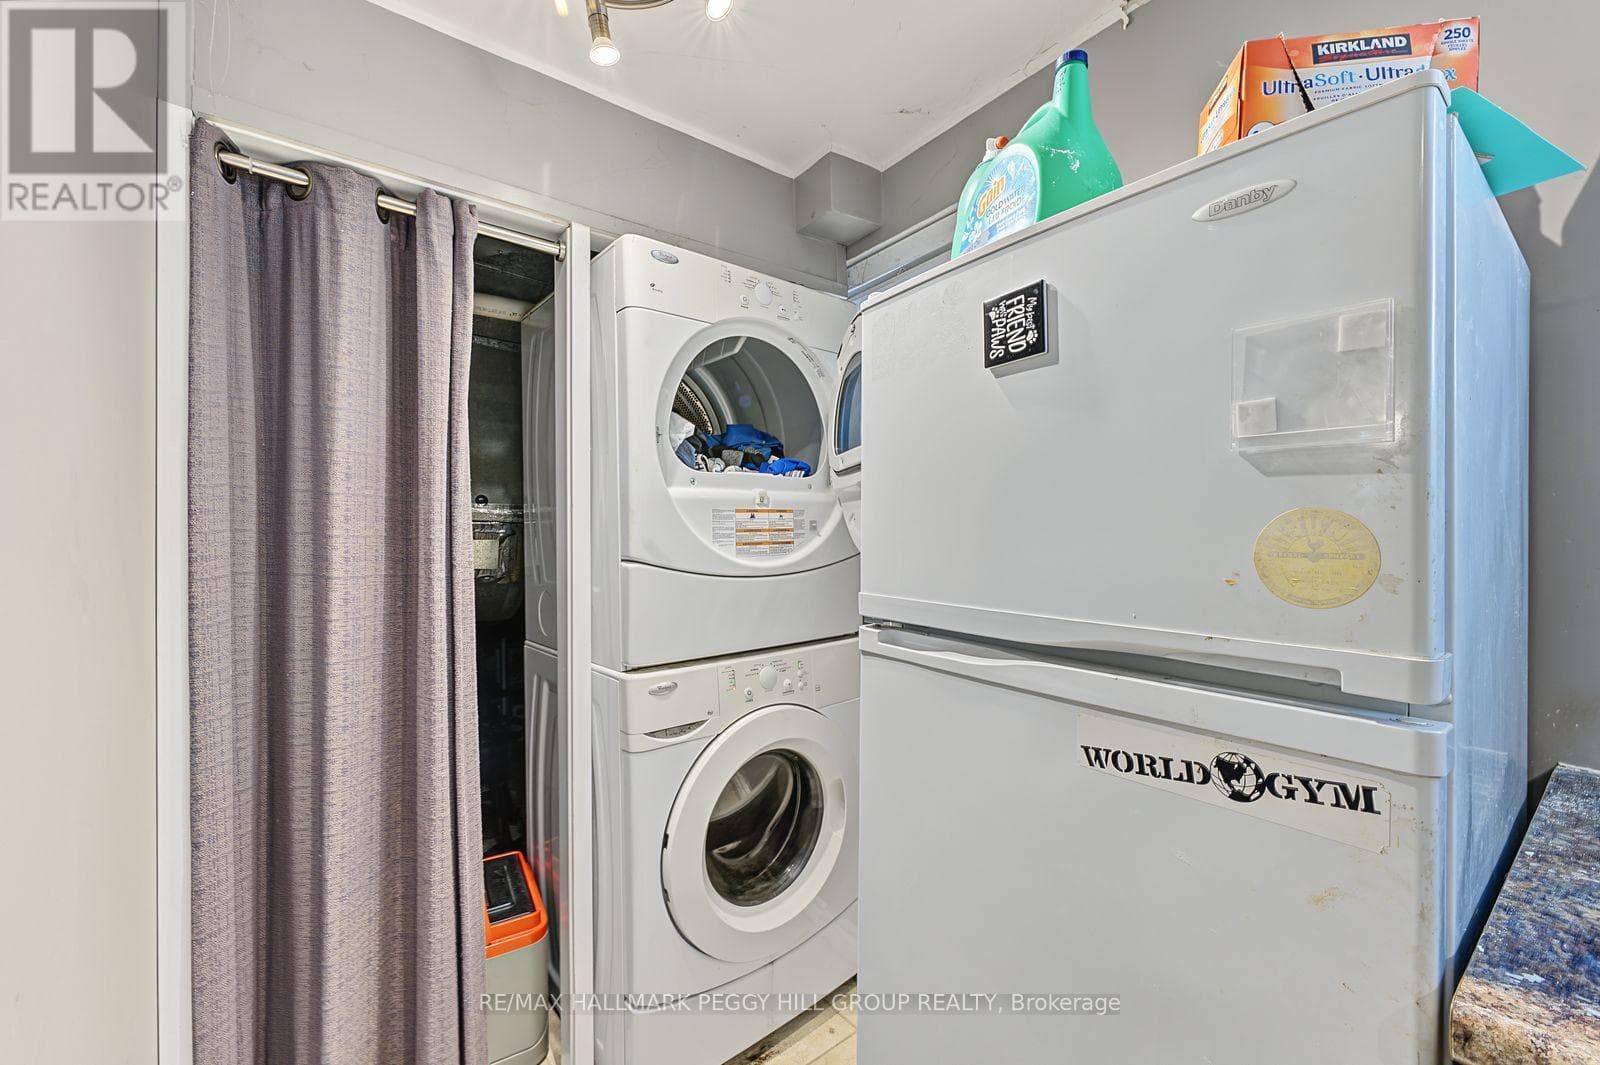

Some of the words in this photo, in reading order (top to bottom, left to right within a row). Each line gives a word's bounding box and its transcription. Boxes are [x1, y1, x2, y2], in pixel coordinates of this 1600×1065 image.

[1444, 27, 1471, 40] 250
[1317, 36, 1407, 56] KIRKLAND
[1208, 184, 1279, 217] Danby
[998, 300, 1008, 318] has
[1026, 297, 1038, 312] My
[1006, 295, 1027, 353] FRIEND
[1026, 311, 1036, 329] best
[989, 318, 1006, 359] PAWS
[1081, 744, 1211, 785] WORLD
[1265, 772, 1382, 815] GYM
